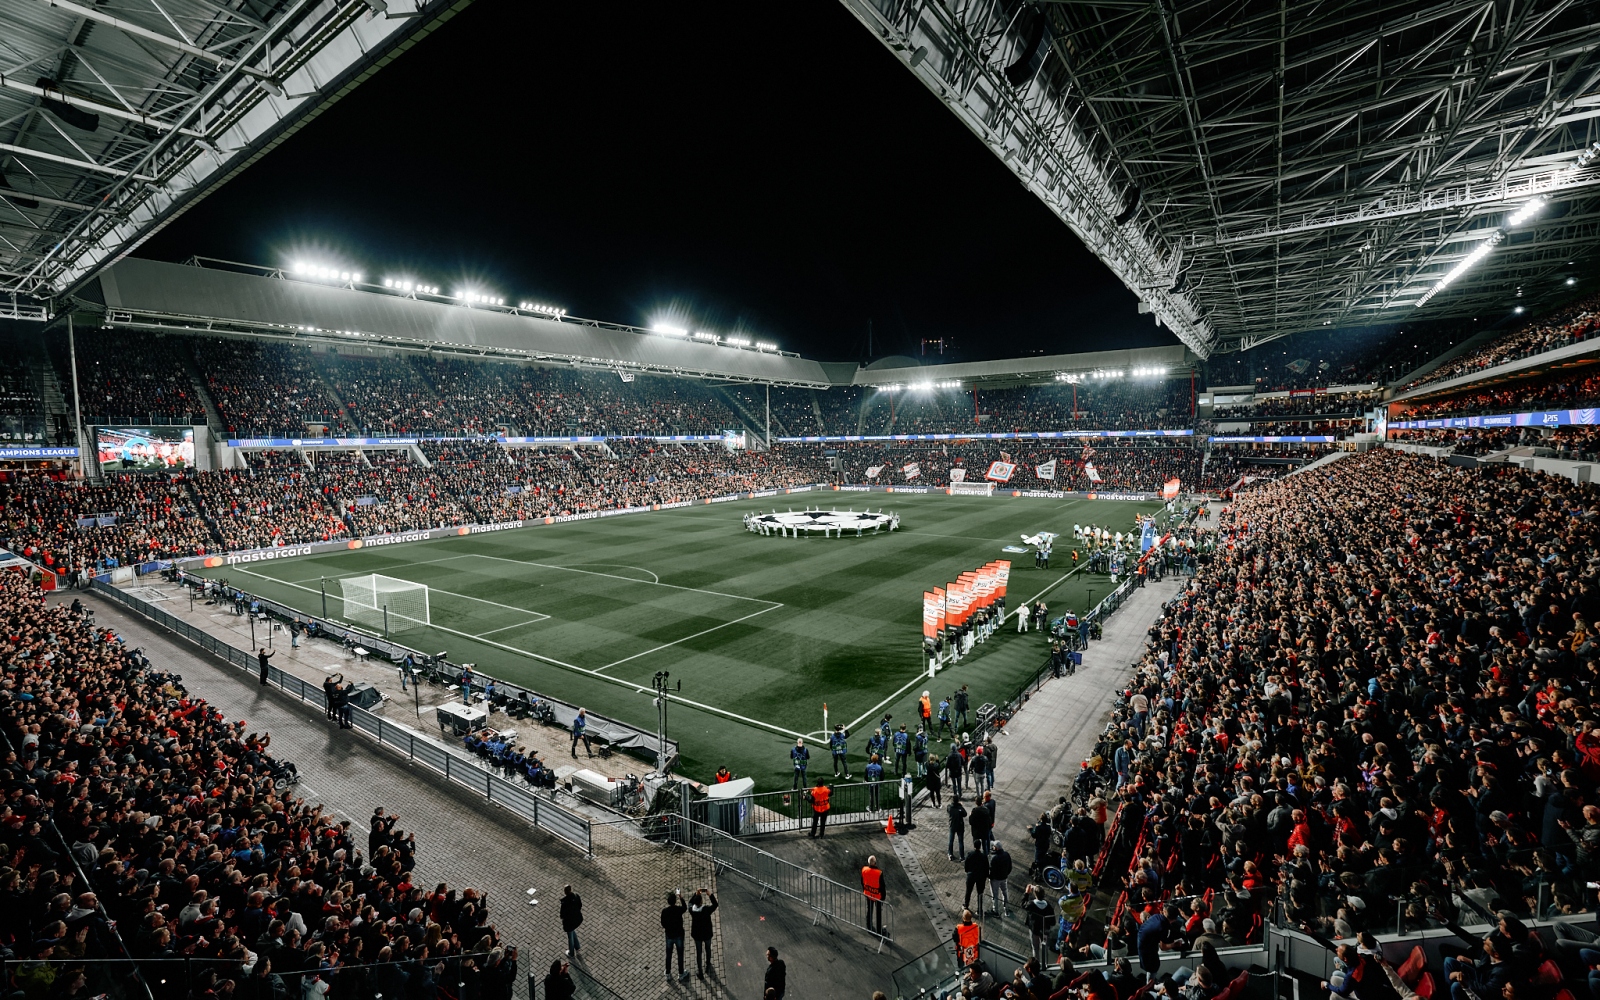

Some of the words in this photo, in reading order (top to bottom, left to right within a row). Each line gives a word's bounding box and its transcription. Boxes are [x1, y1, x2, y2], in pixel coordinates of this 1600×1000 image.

[556, 511, 597, 523] mastercard
[472, 520, 522, 534] mastercard
[366, 532, 430, 547] mastercard
[227, 546, 311, 564] mastercard
